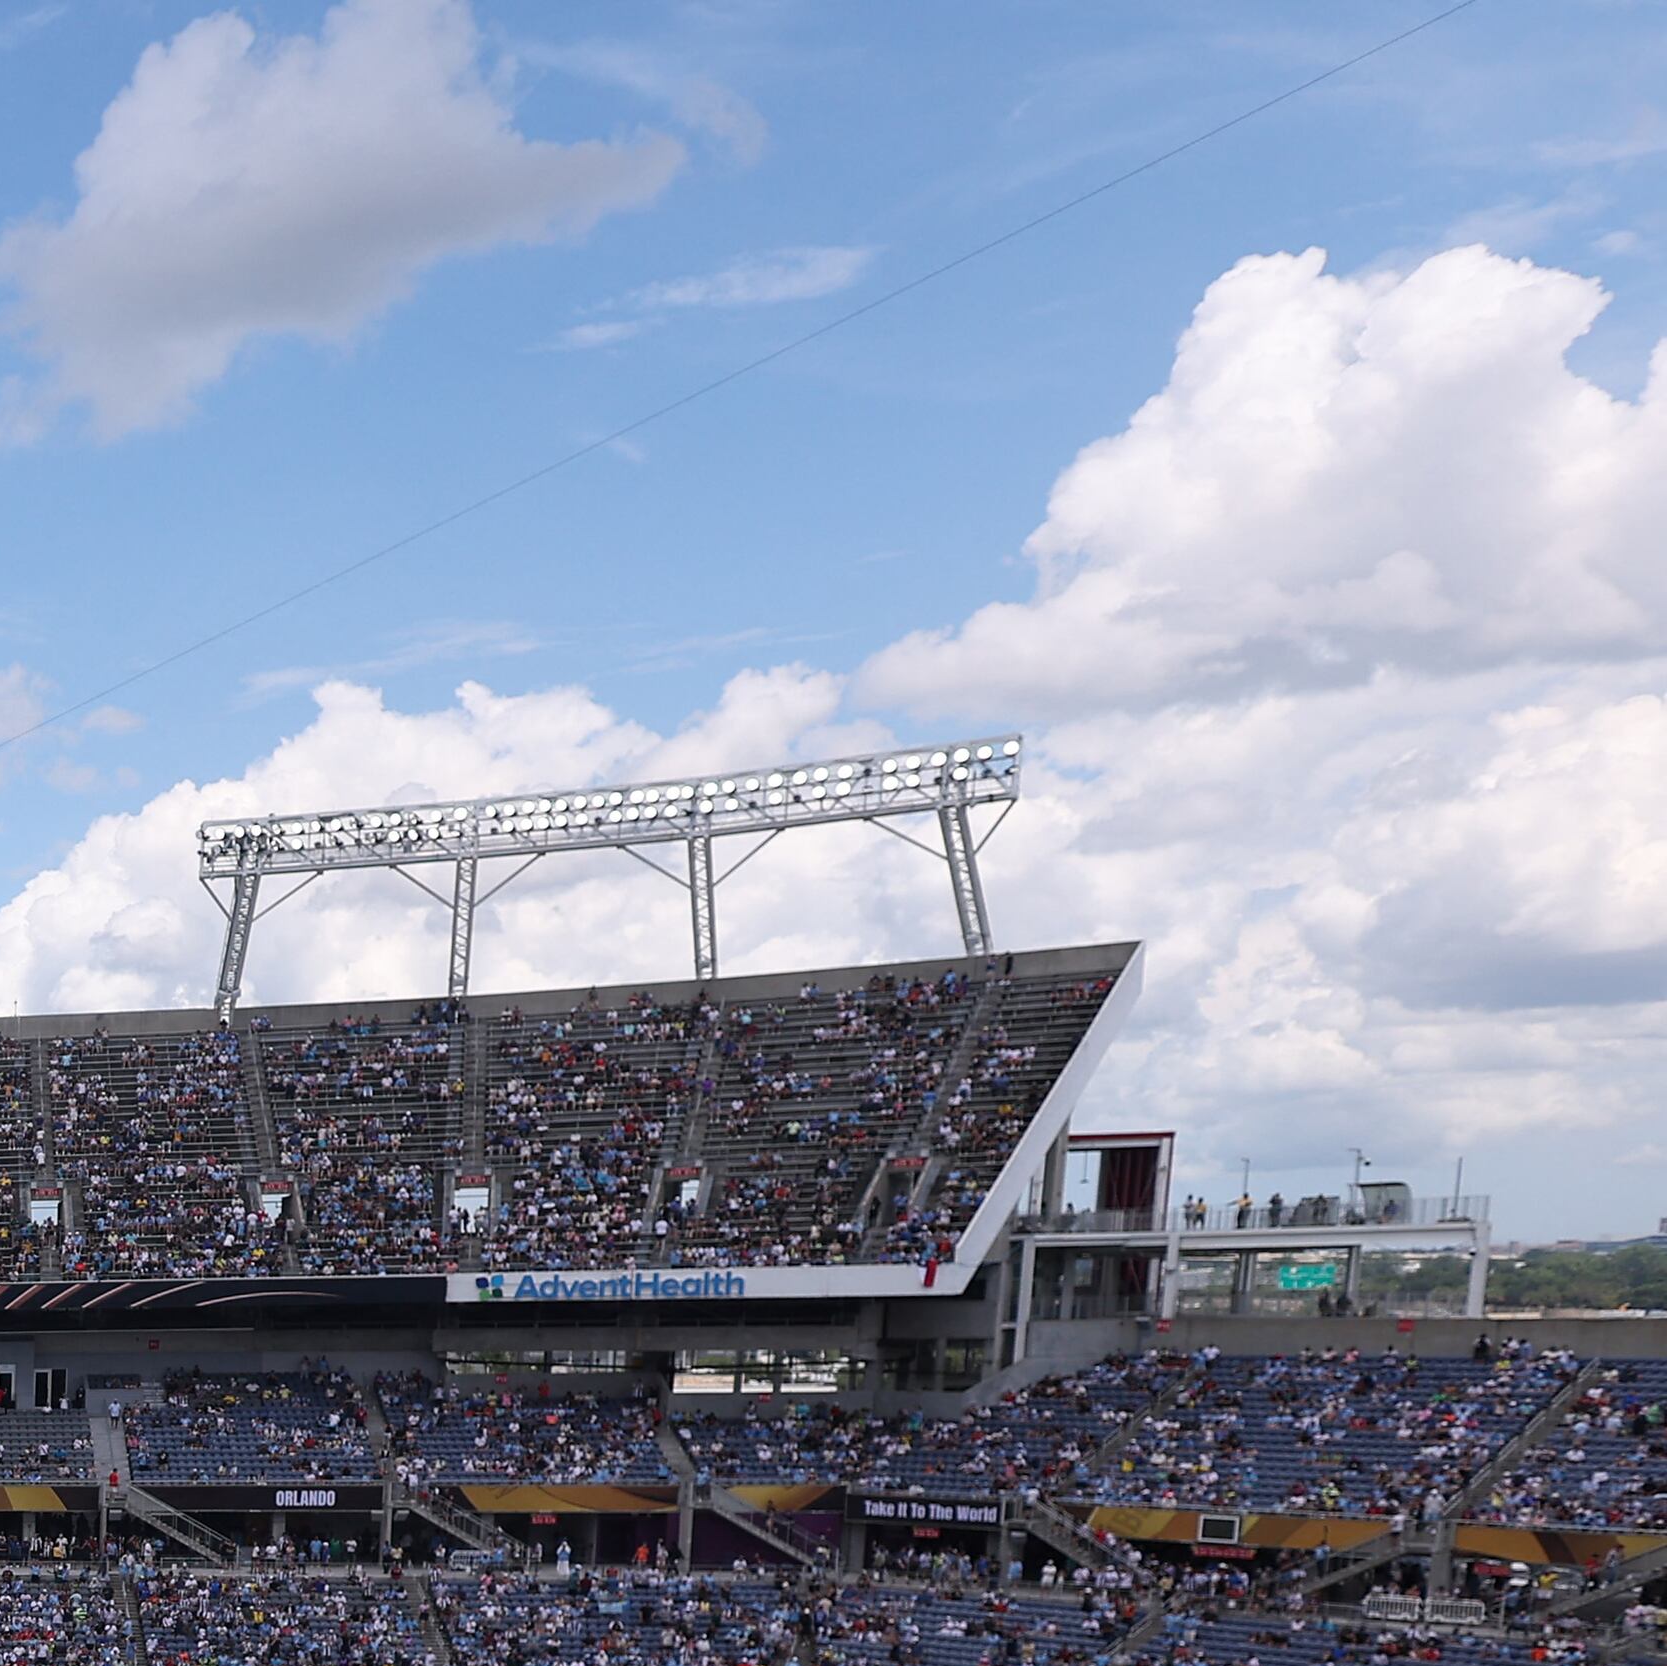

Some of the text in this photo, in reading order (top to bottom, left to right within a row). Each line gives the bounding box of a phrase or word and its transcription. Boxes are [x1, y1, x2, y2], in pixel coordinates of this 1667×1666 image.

[513, 1271, 746, 1300] AdventHealth
[276, 1490, 336, 1507] ORLANDO
[864, 1500, 998, 1523] Take It To The World
